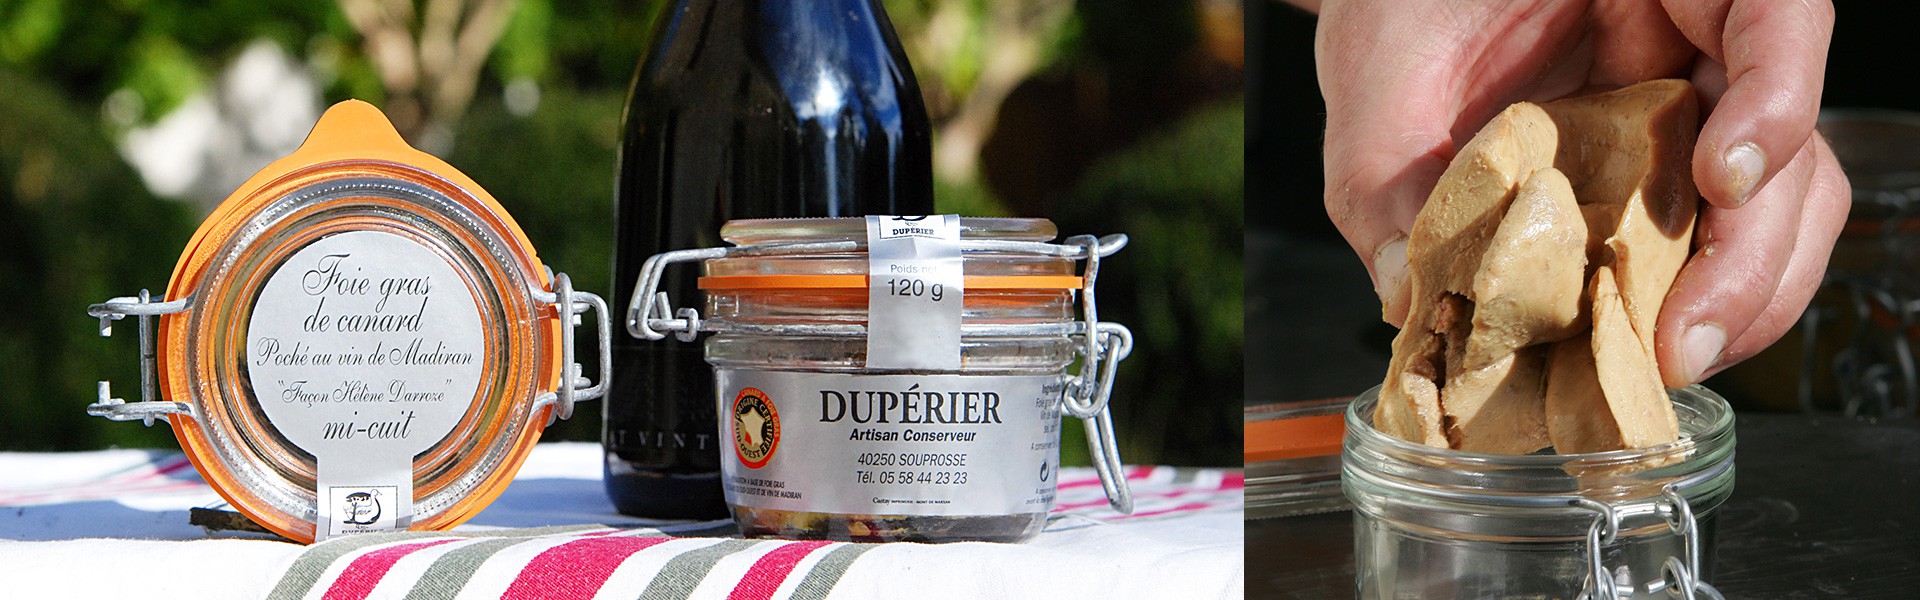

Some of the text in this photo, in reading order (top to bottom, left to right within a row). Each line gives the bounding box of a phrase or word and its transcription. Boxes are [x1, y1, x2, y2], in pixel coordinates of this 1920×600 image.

[890, 264, 918, 274] Poids
[302, 253, 432, 313] Foie gras
[887, 278, 944, 302] 120 g
[303, 296, 429, 332] de canard
[255, 336, 473, 367] Poché au vin de Madiran
[331, 378, 385, 404] Hélène
[820, 382, 1003, 424] DUPÉRIER
[322, 410, 416, 440] mi-cuit
[849, 428, 977, 442] Artisan Conserveur
[857, 453, 968, 467] 40250 SOUPROSSE
[856, 470, 968, 485] Tél. 05 58 44 23 23
